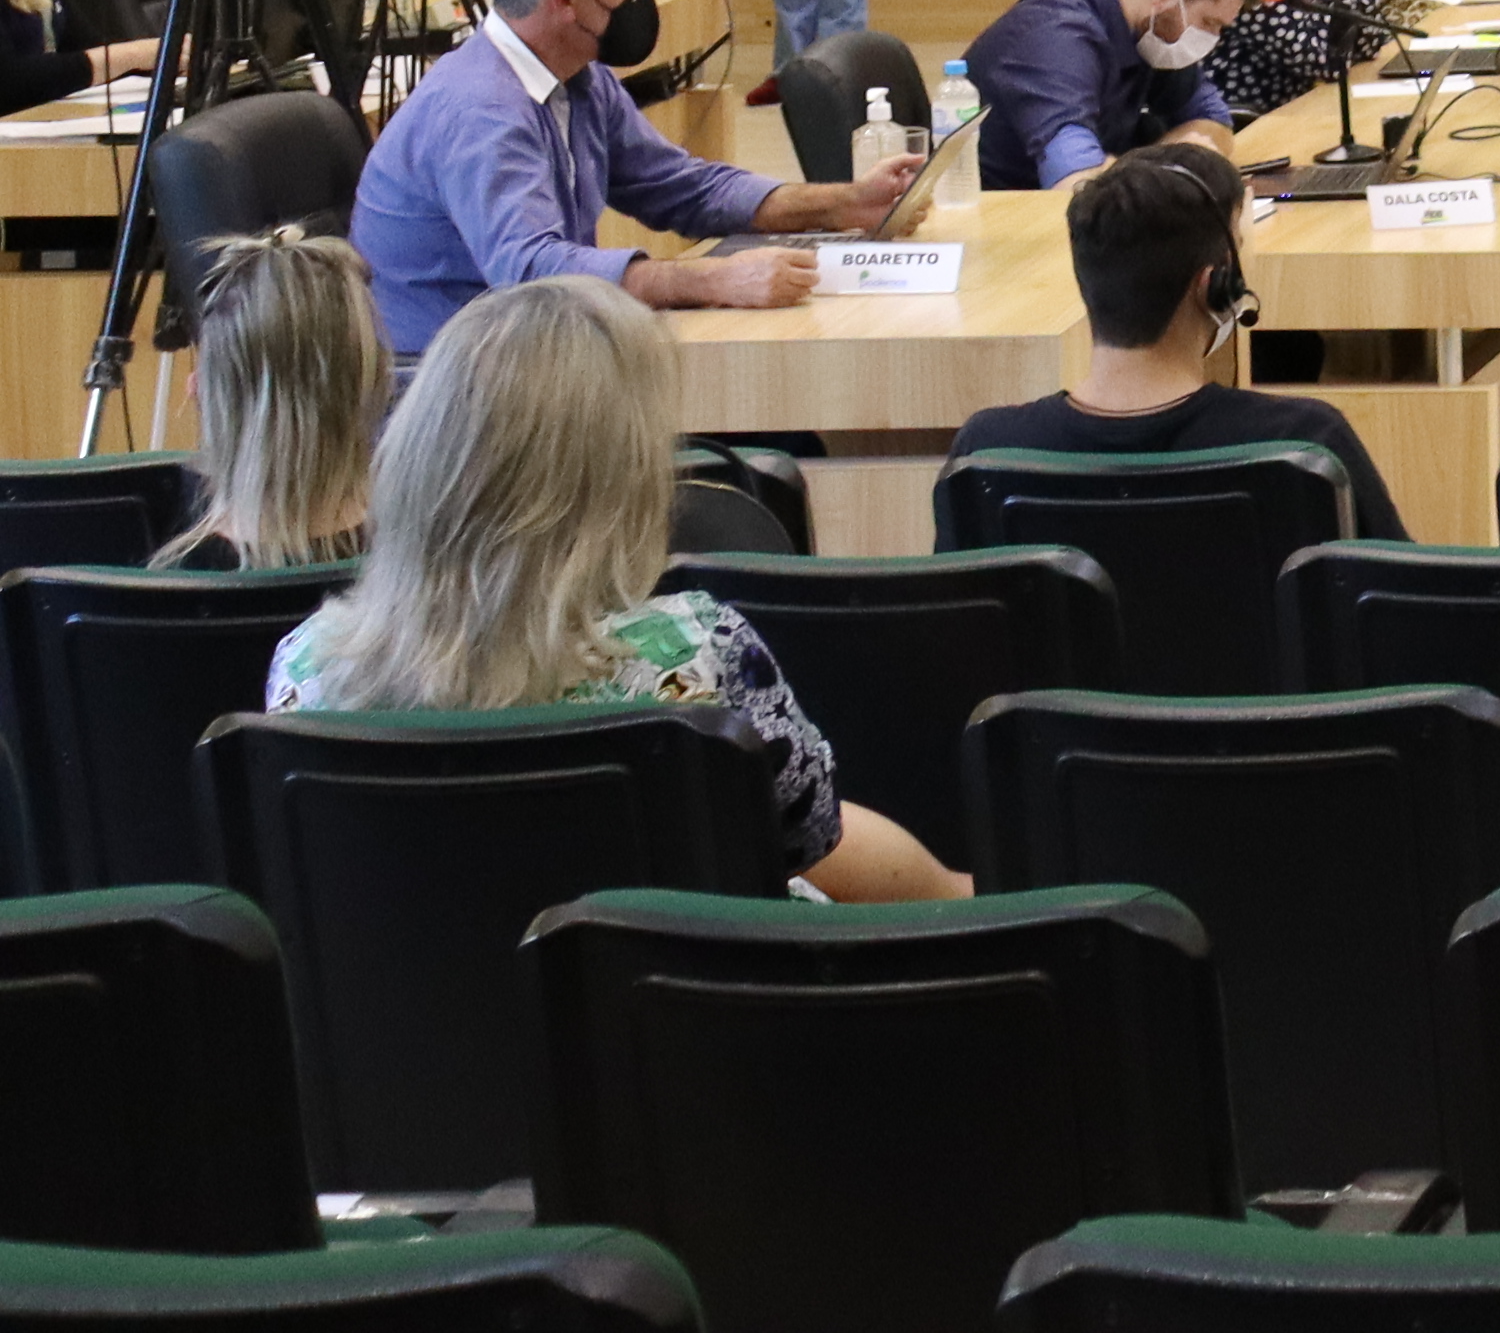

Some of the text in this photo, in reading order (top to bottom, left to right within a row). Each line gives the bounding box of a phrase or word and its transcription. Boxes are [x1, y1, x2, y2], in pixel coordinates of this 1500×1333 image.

[1384, 190, 1479, 206] DALA COSTA
[841, 253, 939, 265] BOARETTO
